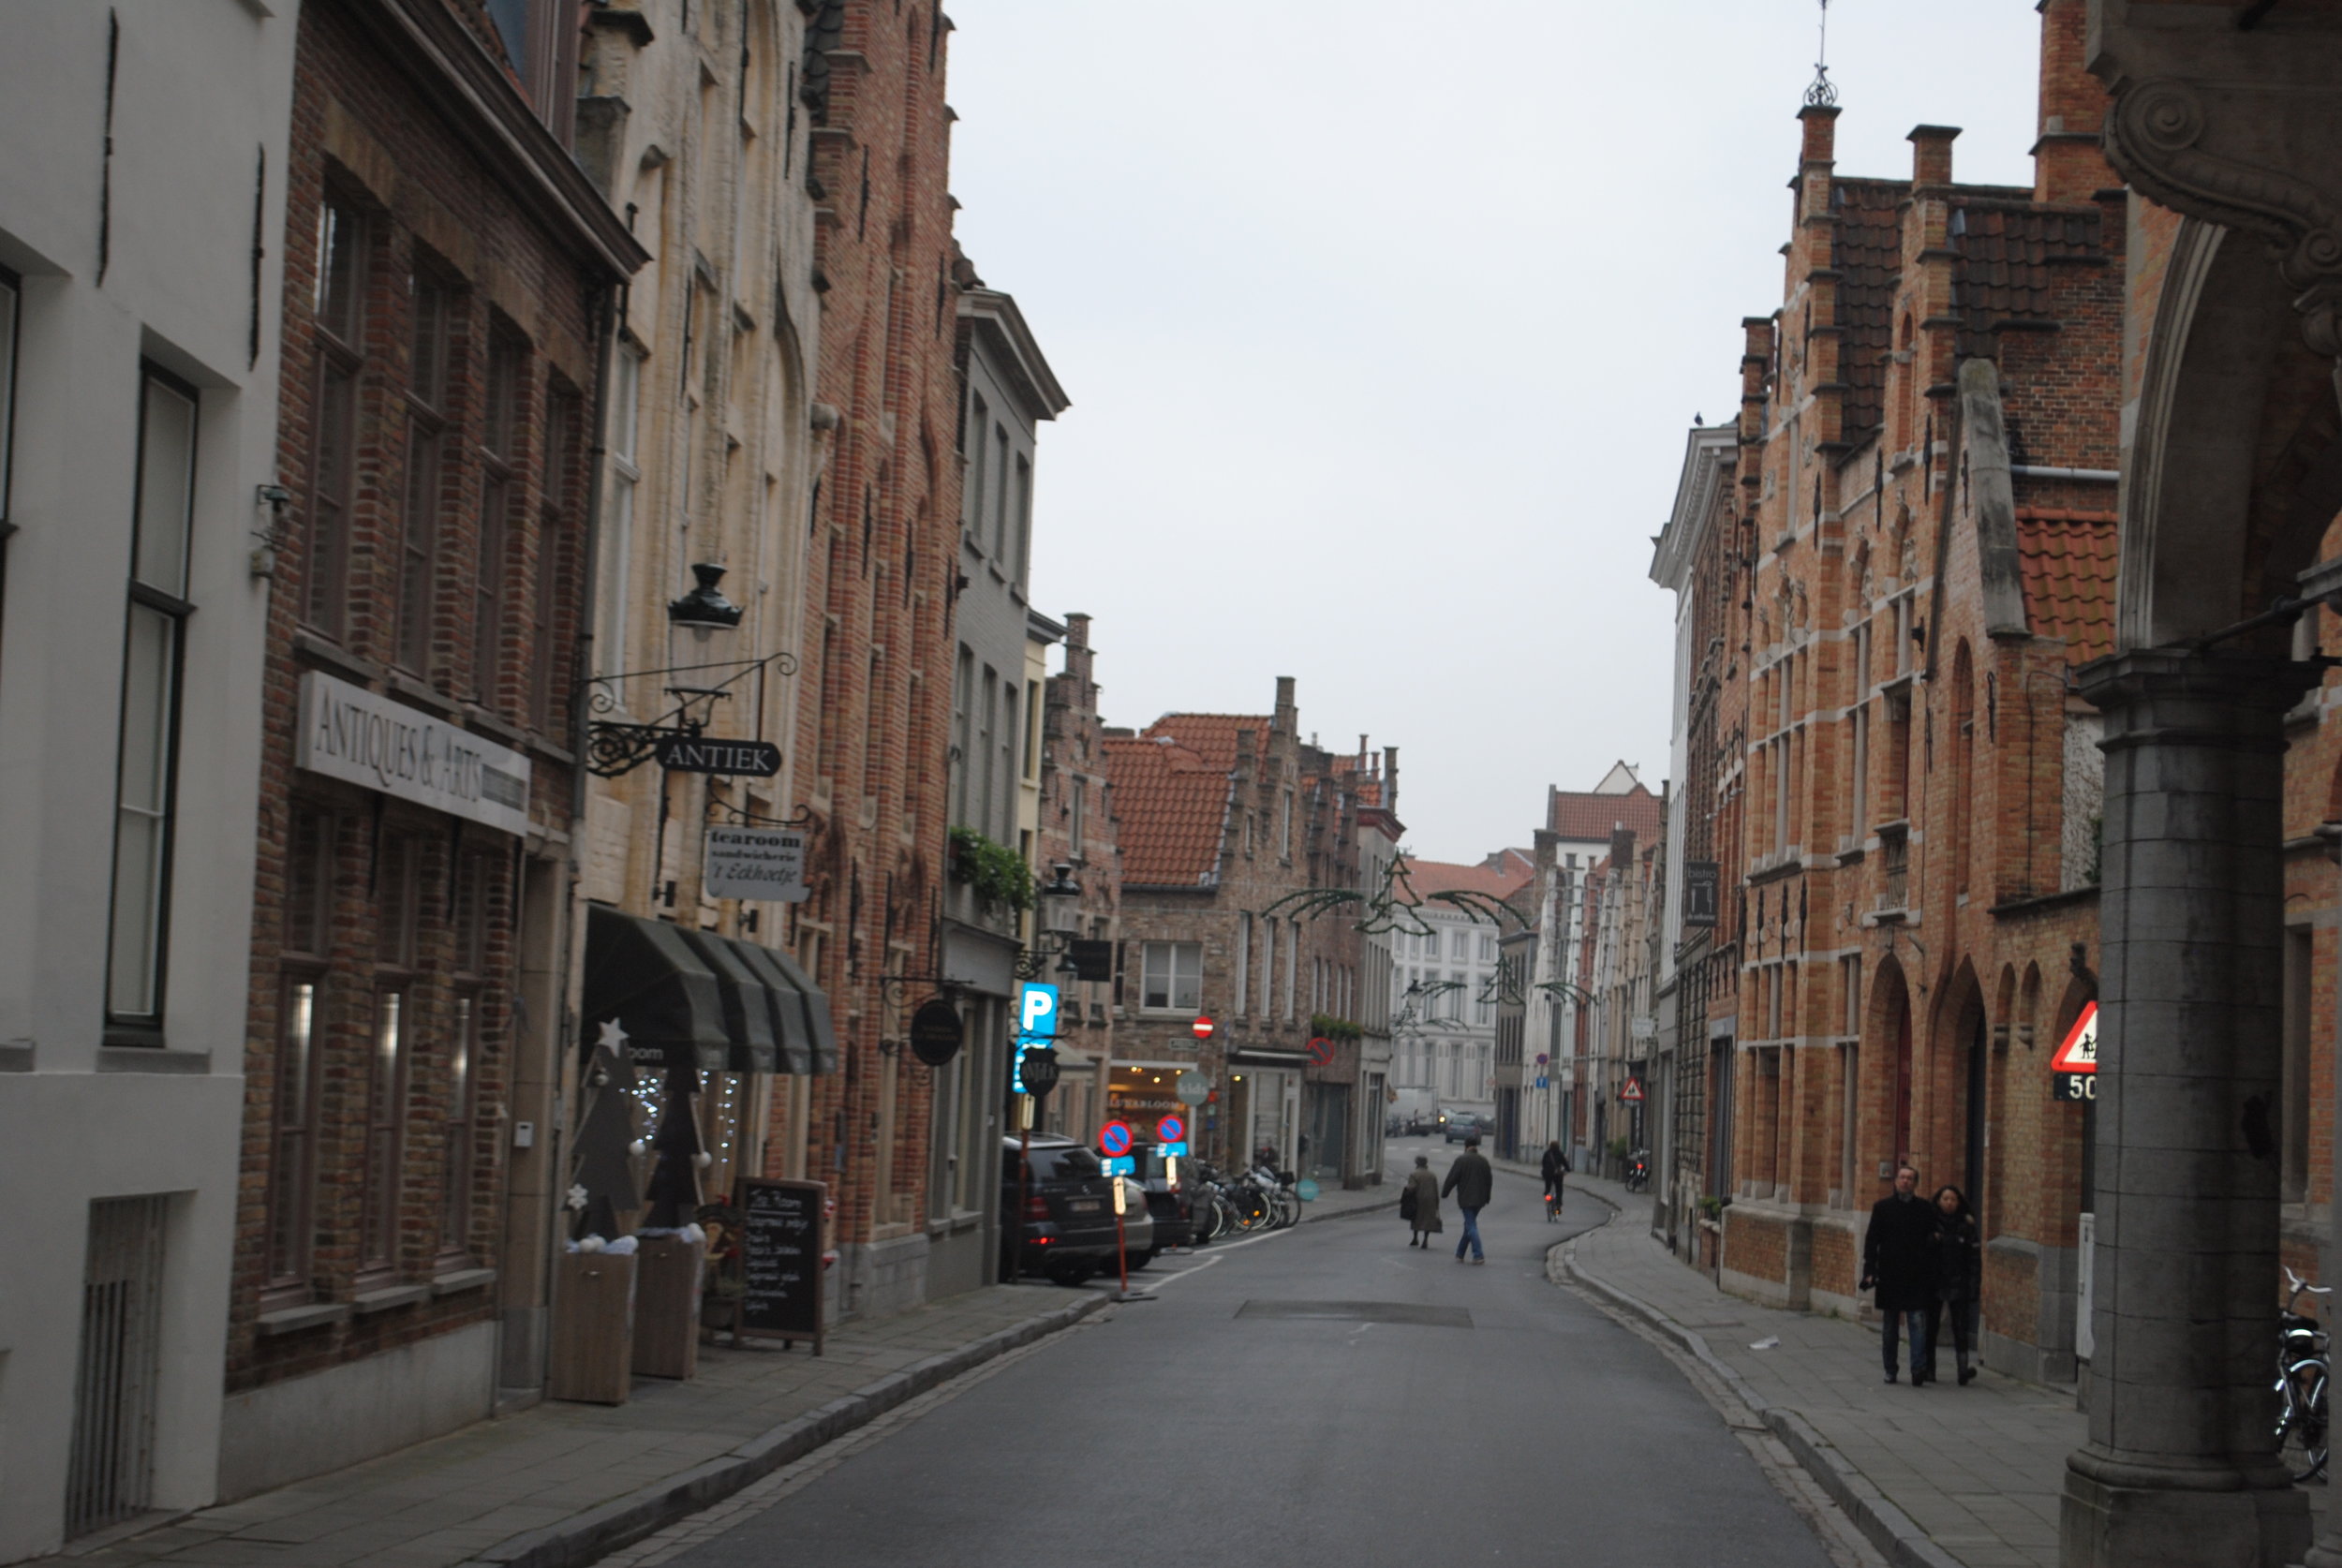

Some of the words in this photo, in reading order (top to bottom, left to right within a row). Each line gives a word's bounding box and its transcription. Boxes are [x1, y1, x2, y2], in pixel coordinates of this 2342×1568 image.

[316, 684, 416, 788] ANTIQUES
[422, 724, 435, 789] &
[665, 744, 771, 772] ANTIEK
[710, 831, 801, 849] tearoom
[1687, 866, 1717, 880] bistro
[1022, 990, 1053, 1031] P
[1178, 1082, 1209, 1096] kids
[2068, 1074, 2097, 1101] 50
